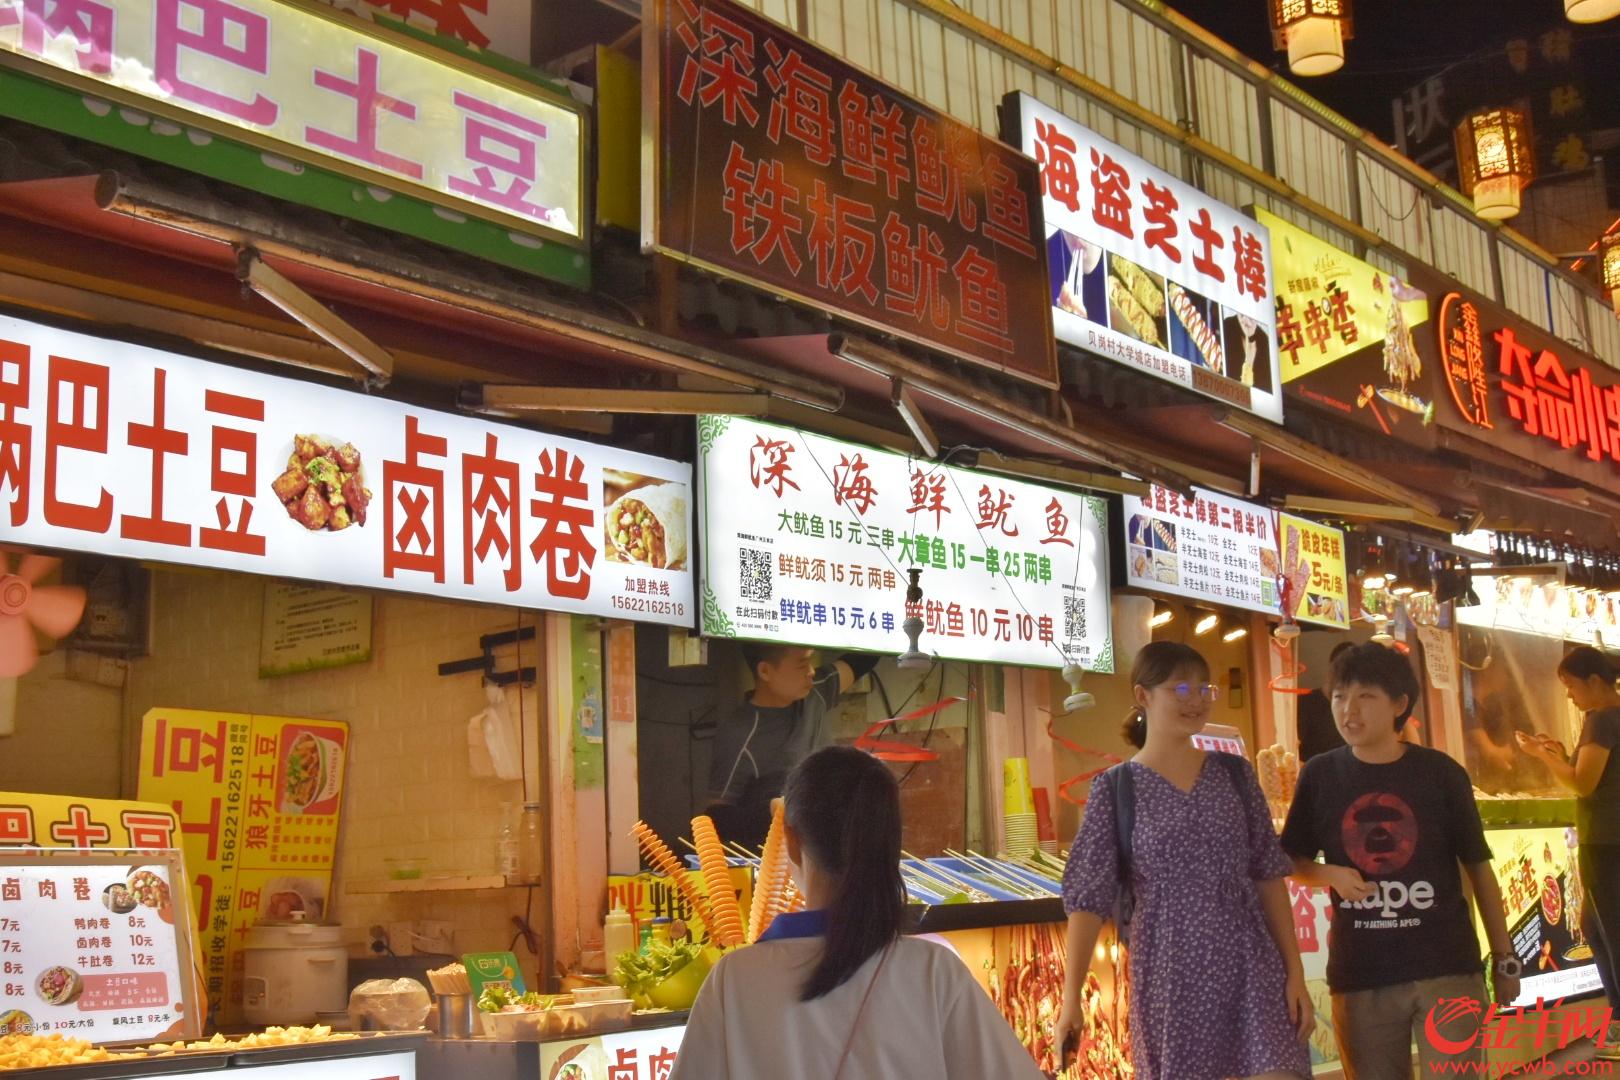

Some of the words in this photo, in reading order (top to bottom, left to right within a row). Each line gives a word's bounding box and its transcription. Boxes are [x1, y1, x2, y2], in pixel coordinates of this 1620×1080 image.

[675, 0, 1037, 260] 深海鲜鱿鱼
[1034, 117, 1267, 303] 海盗芝士棒
[722, 140, 1015, 354] 铁板鱿鱼
[749, 433, 1075, 549] 深海鲜鱿鱼
[382, 414, 598, 601] 卤肉卷
[625, 576, 671, 597] 加盟热线
[610, 594, 685, 616] 15622162518
[245, 733, 278, 849] 狼牙土豆
[1, 877, 92, 901] 卤肉卷
[74, 917, 111, 930] 鸭肉卷
[128, 916, 146, 928] 8元
[2, 939, 22, 953] 7元
[76, 936, 113, 949] 卤肉卷
[129, 934, 154, 947] 10元
[3, 961, 24, 975] 8元
[77, 955, 114, 968] 牛肚卷
[131, 953, 156, 966] 12元
[5, 983, 25, 996] 8元
